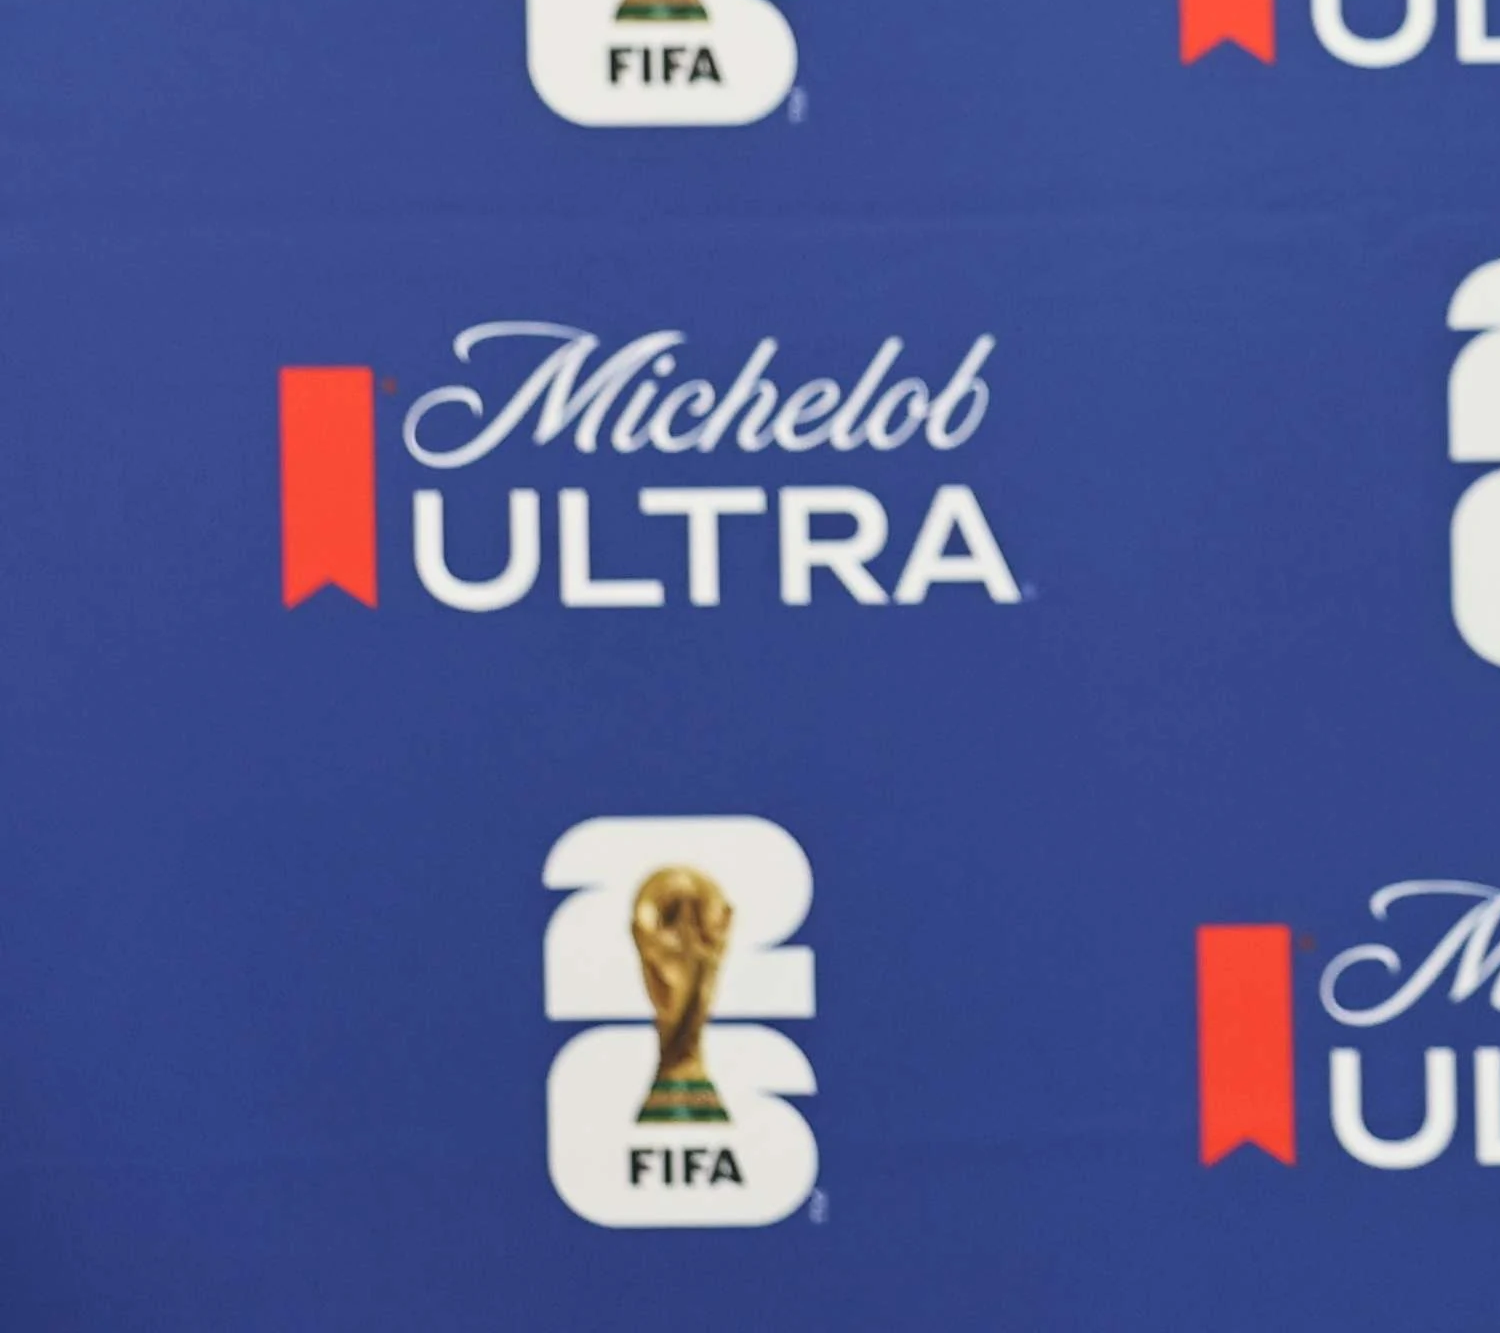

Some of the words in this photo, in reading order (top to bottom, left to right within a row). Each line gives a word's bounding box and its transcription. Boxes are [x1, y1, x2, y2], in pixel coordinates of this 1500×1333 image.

[610, 47, 721, 83] FIFA
[403, 322, 995, 468] Michelob
[413, 485, 1021, 612] ULTRA
[630, 1149, 742, 1185] FIFA
